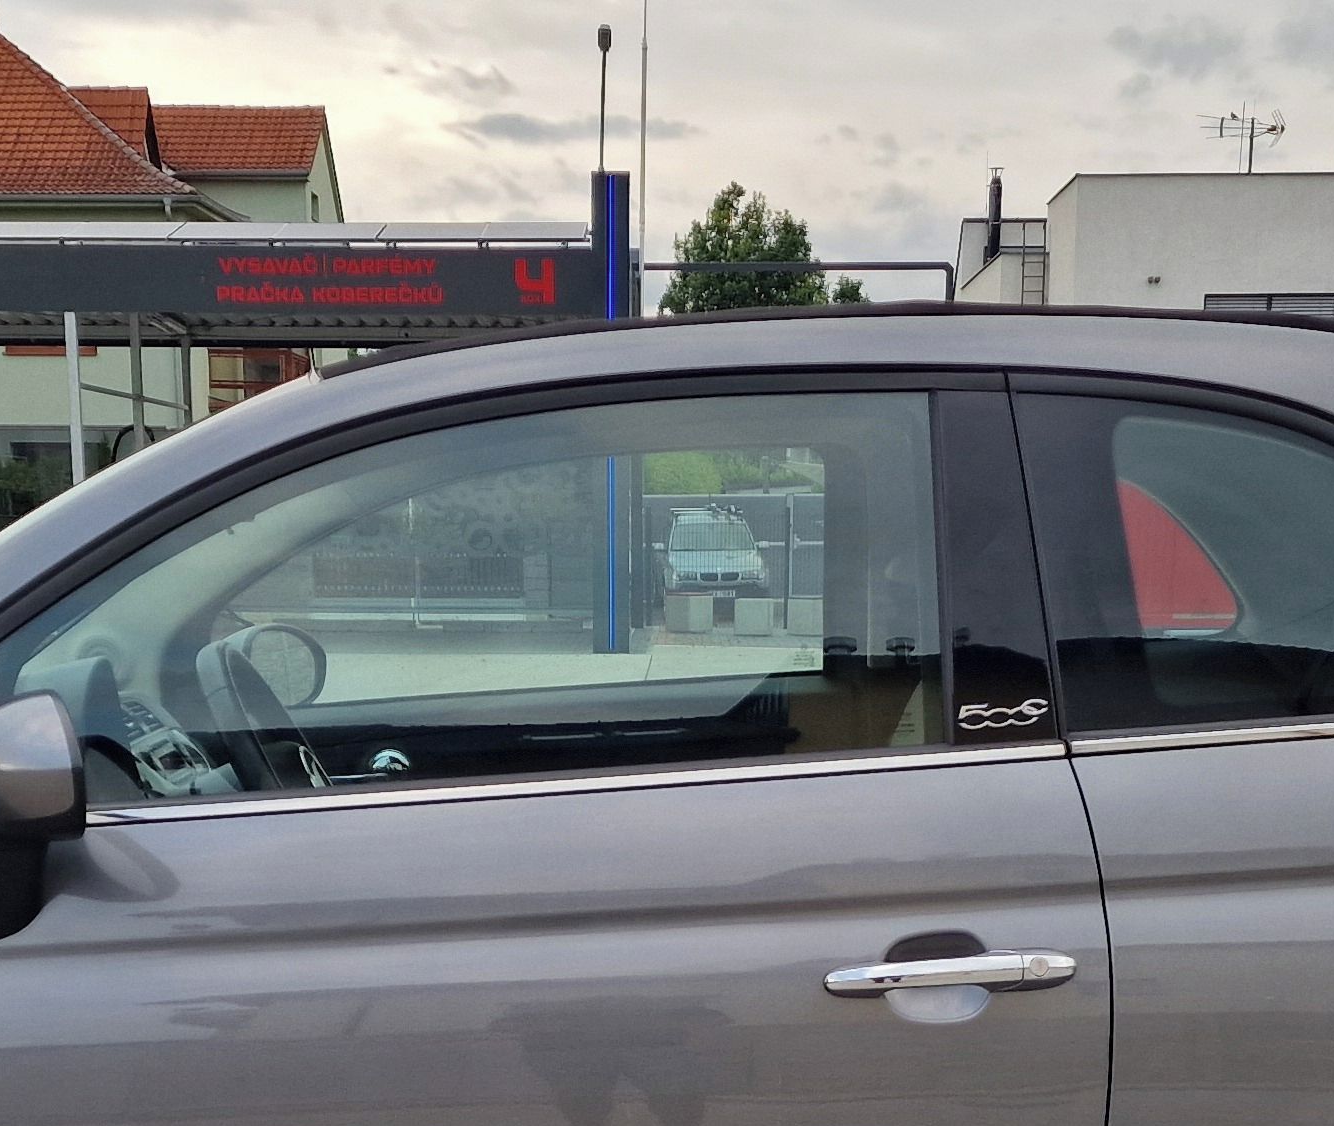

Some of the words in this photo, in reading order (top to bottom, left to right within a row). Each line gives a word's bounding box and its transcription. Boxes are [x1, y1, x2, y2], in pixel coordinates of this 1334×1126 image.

[218, 255, 318, 276] VYSAVAČ
[332, 255, 436, 276] PARFÉMY
[217, 281, 305, 304] PRAČKA
[514, 258, 556, 304] 4
